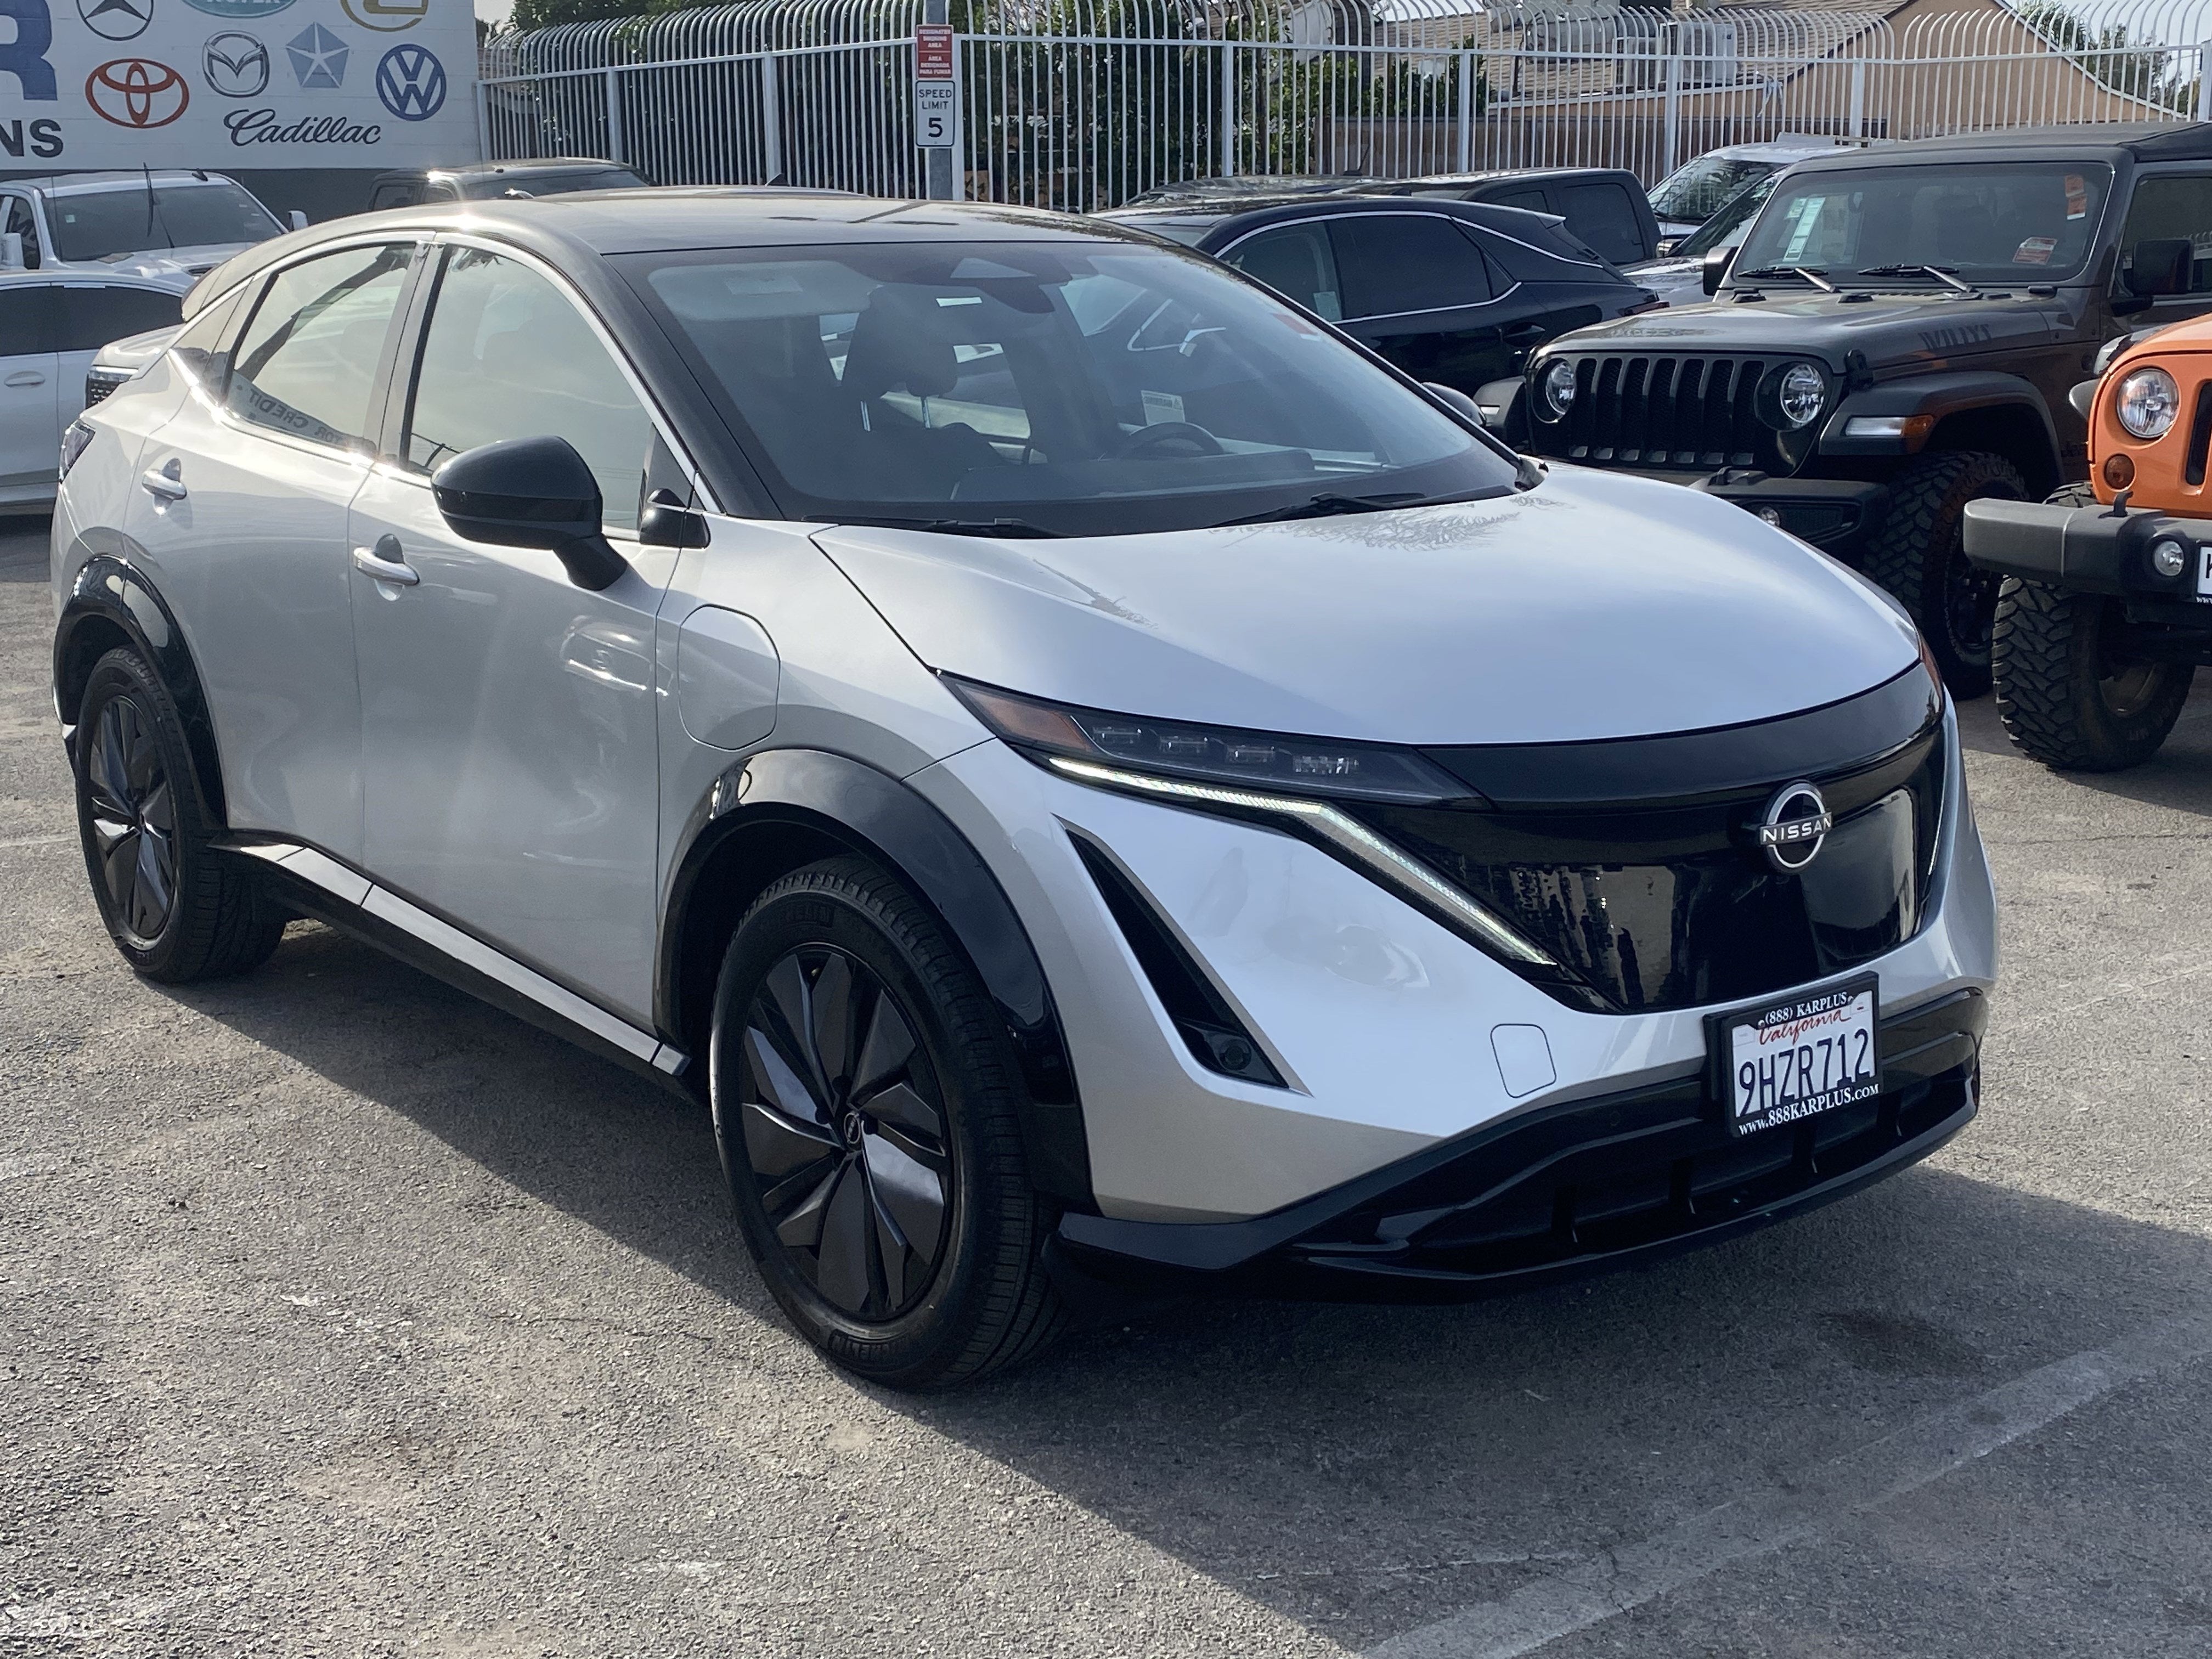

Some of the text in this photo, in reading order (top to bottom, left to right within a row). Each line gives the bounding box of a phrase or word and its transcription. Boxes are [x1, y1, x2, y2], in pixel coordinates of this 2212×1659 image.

[919, 89, 952, 98] SPEED
[922, 101, 949, 109] LIMIT
[223, 109, 381, 146] Cadillac
[928, 117, 943, 137] 5
[1762, 815, 1831, 842] NISSAN
[1765, 991, 1847, 1025] (888) KARPLUS
[1759, 1009, 1852, 1045] California
[1739, 1028, 1870, 1117] 9HZR712
